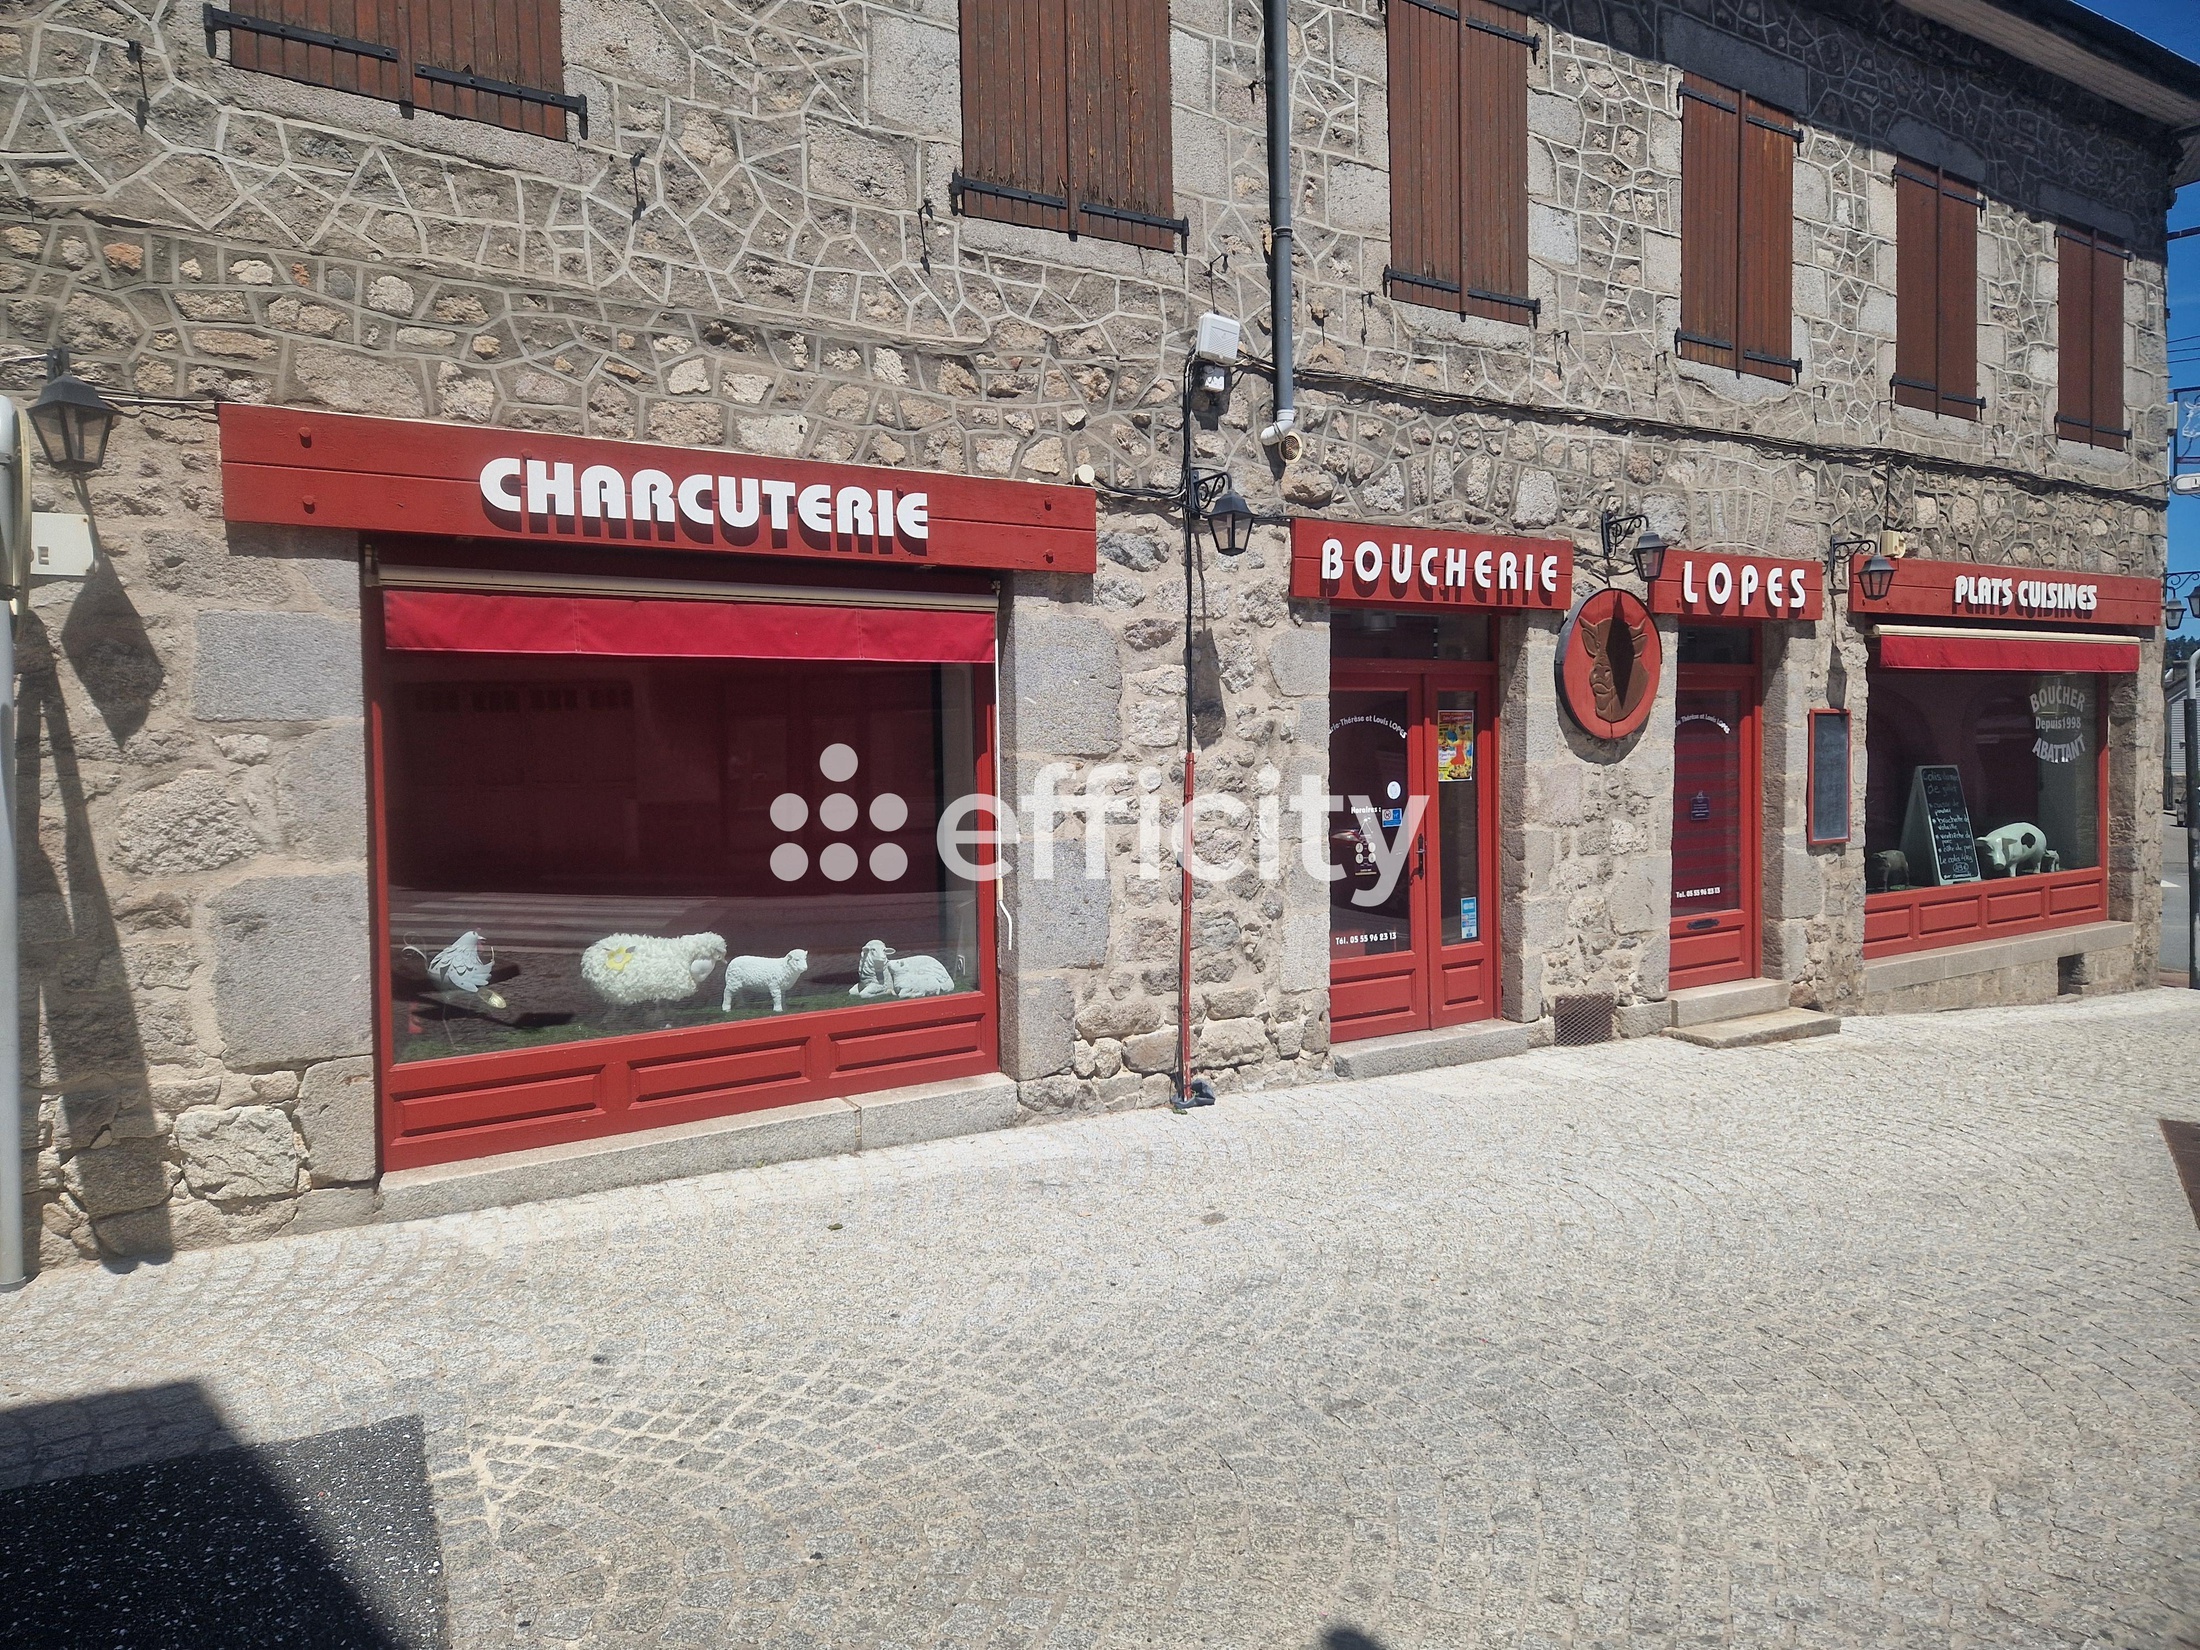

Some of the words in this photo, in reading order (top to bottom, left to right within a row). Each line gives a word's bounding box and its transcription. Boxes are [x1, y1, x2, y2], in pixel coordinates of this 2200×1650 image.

[479, 457, 929, 539] CHARCUTERIE
[1321, 537, 1558, 592] BOUCHERIE
[1682, 560, 1806, 609] LOPES
[1954, 575, 2013, 607] PLATS
[2017, 580, 2097, 611] CUISINES
[2029, 684, 2085, 713] BOUCHER
[1373, 715, 1389, 726] Louis
[1389, 720, 1408, 739] LOPES
[2031, 732, 2086, 764] ABATTANT
[1350, 935, 1359, 944] 05
[1359, 934, 1368, 943] 55
[1369, 933, 1378, 942] 96
[1379, 932, 1388, 941] 23
[1389, 931, 1397, 940] 13
